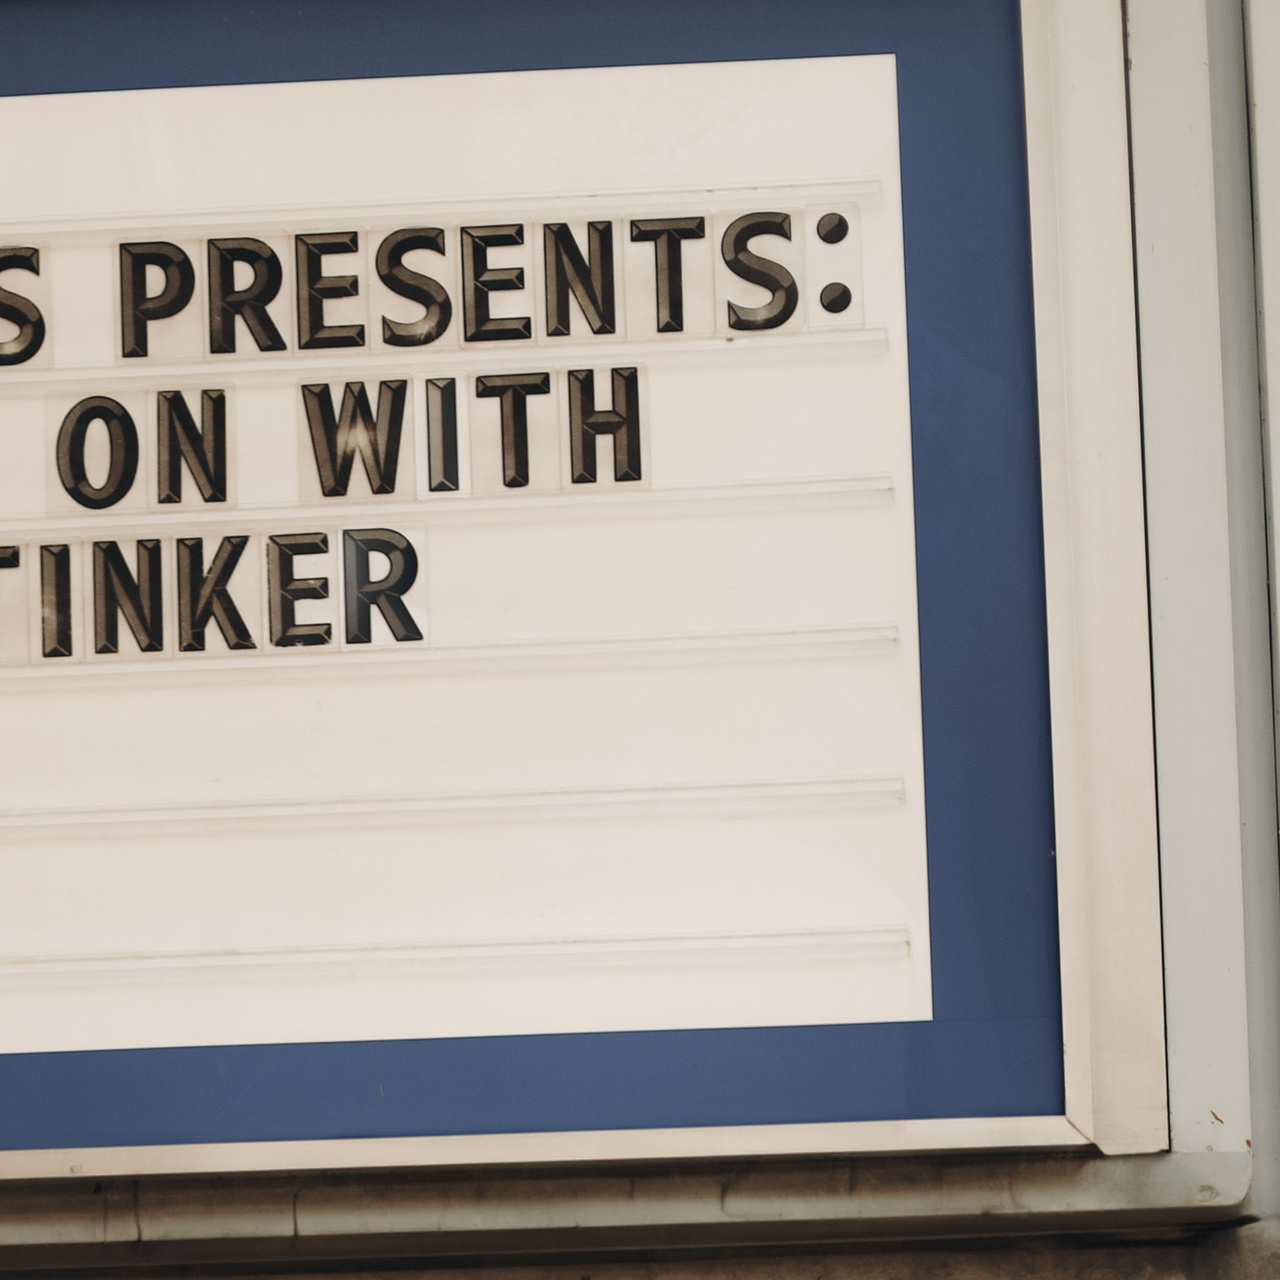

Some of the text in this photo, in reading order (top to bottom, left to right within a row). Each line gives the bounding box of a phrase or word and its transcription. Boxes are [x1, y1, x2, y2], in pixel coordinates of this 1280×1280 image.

[118, 211, 852, 359] PRESENTS:
[55, 388, 228, 511] ON
[300, 366, 643, 498] WITH
